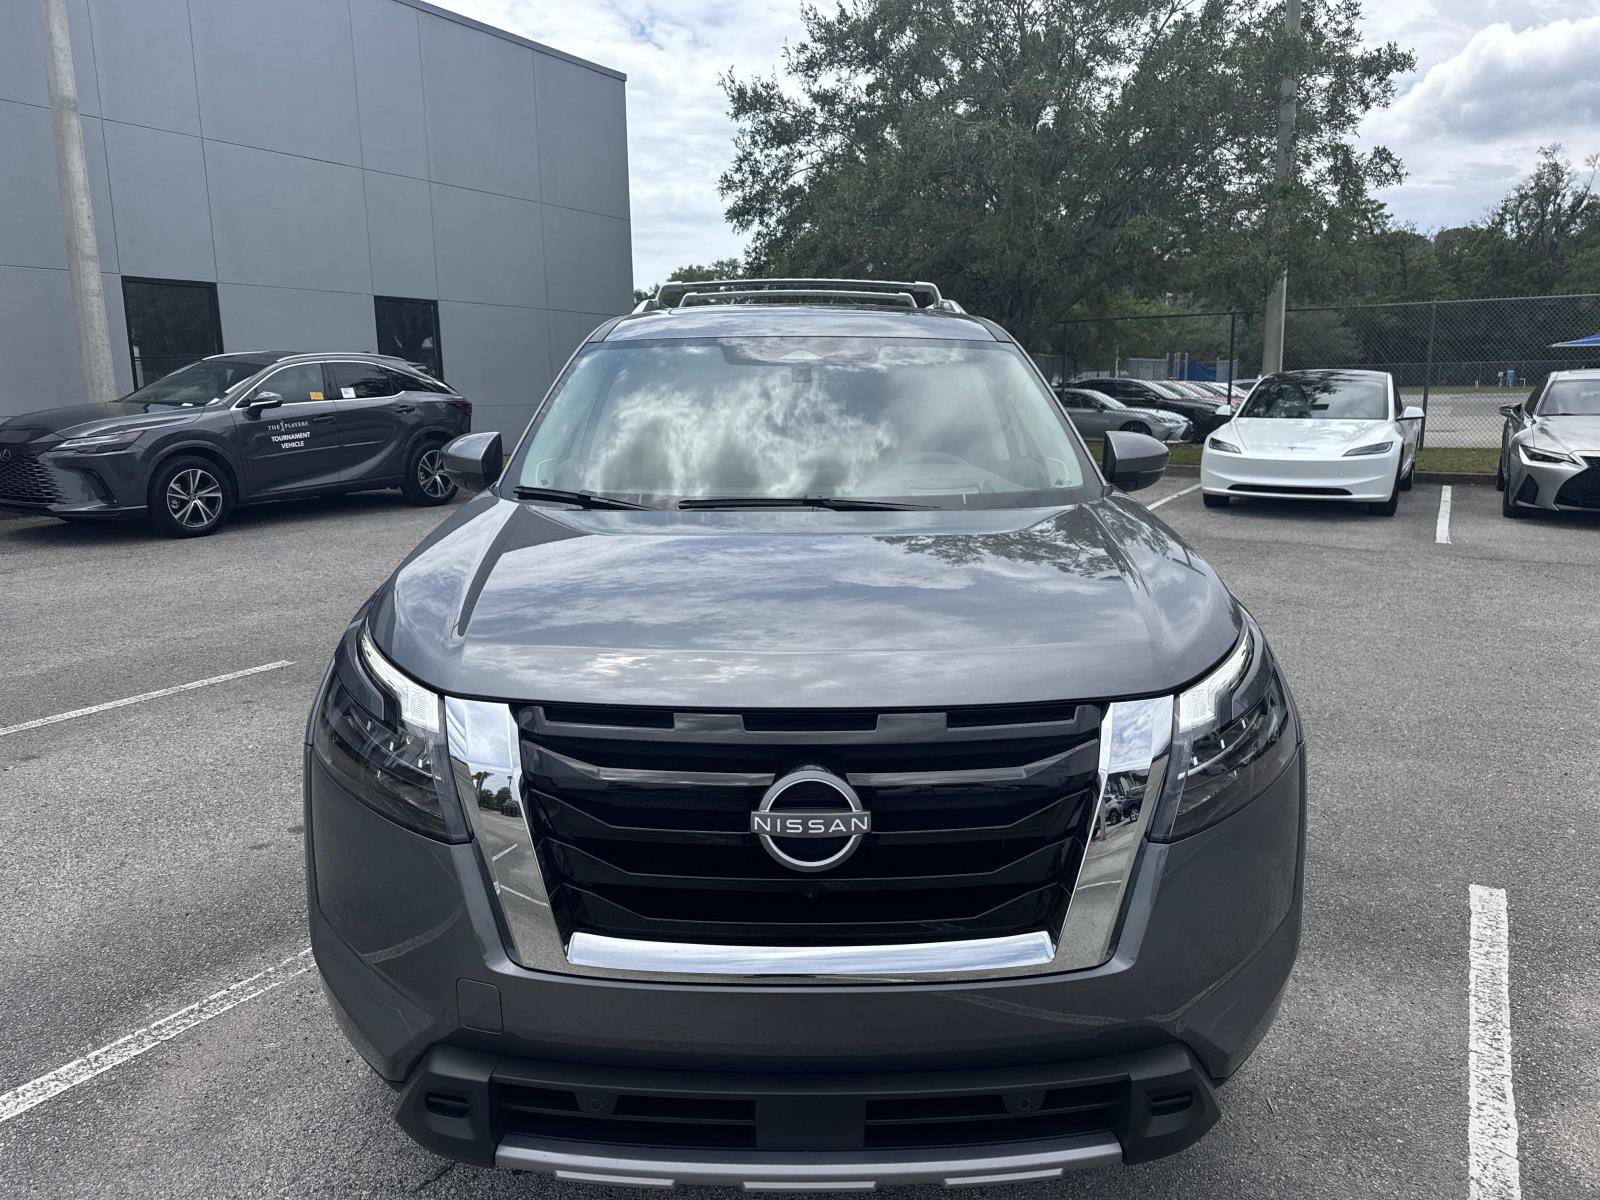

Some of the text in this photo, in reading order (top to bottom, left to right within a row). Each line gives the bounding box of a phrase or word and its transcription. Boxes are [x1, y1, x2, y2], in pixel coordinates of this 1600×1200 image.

[284, 421, 309, 429] PLAYERS
[271, 431, 311, 442] TOURNAMENT
[280, 440, 305, 449] VEHICLE
[754, 816, 868, 833] NISSAN
